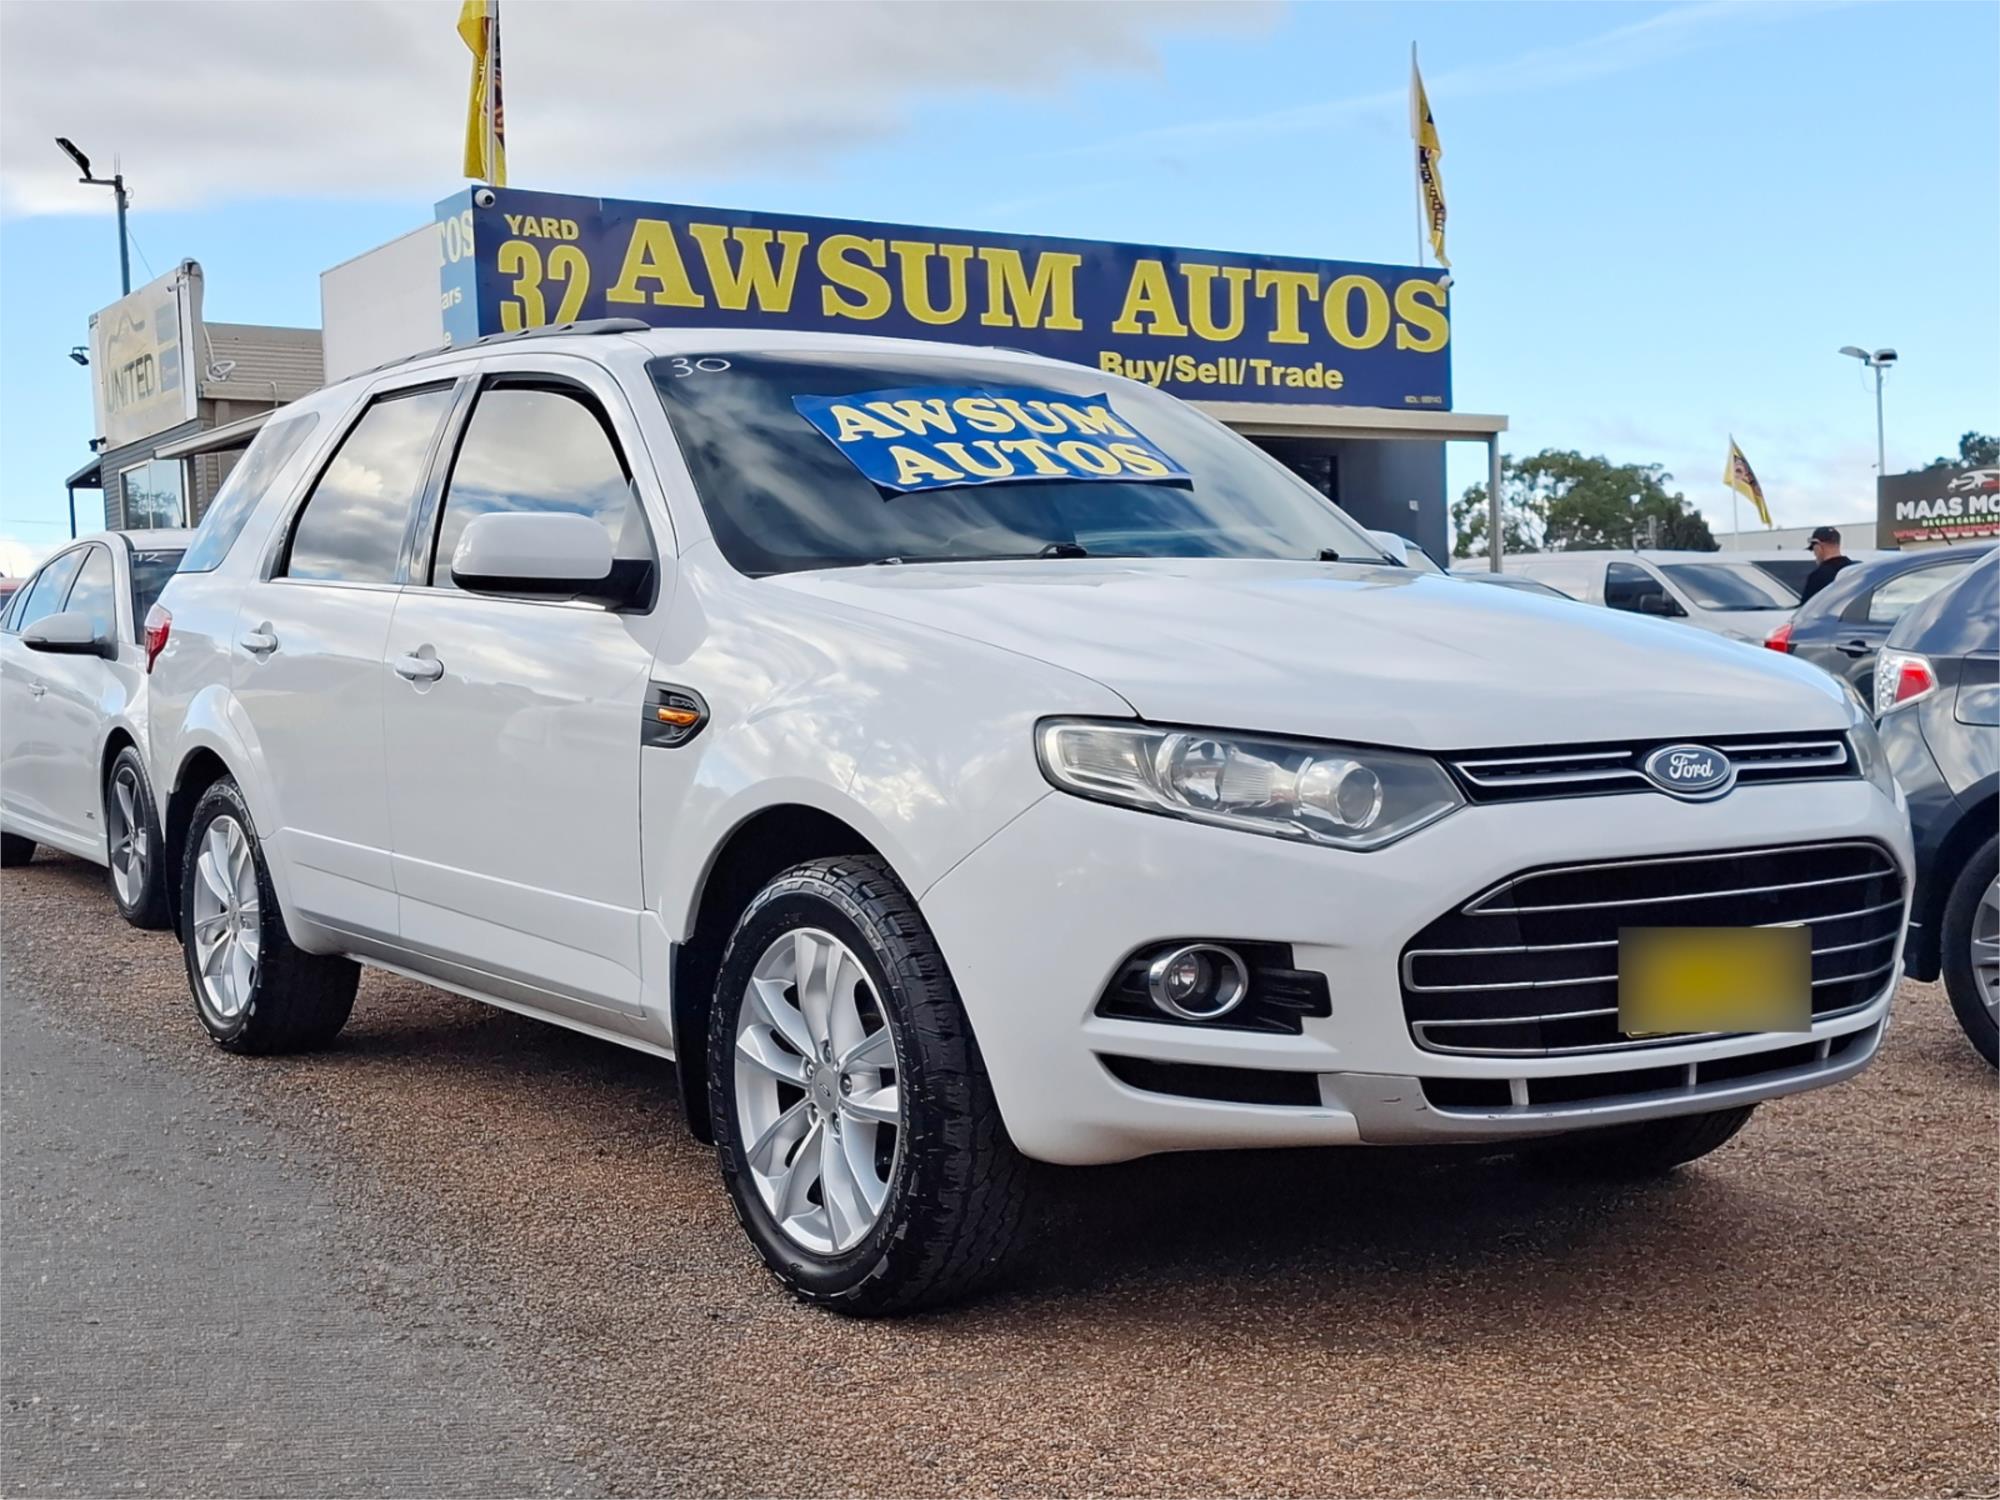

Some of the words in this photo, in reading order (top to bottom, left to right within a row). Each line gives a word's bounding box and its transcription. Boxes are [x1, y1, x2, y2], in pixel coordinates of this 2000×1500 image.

[504, 214, 580, 241] YARD
[498, 239, 591, 333] 32
[606, 218, 1084, 332] AWSUM
[1112, 259, 1450, 352] AUTOS
[105, 352, 156, 413] UNITED
[672, 358, 732, 378] 30
[829, 397, 1138, 443] AWSUM
[888, 439, 1171, 485] AUTOS
[1896, 496, 1964, 521] MAAS
[1668, 752, 1714, 779] Ford
